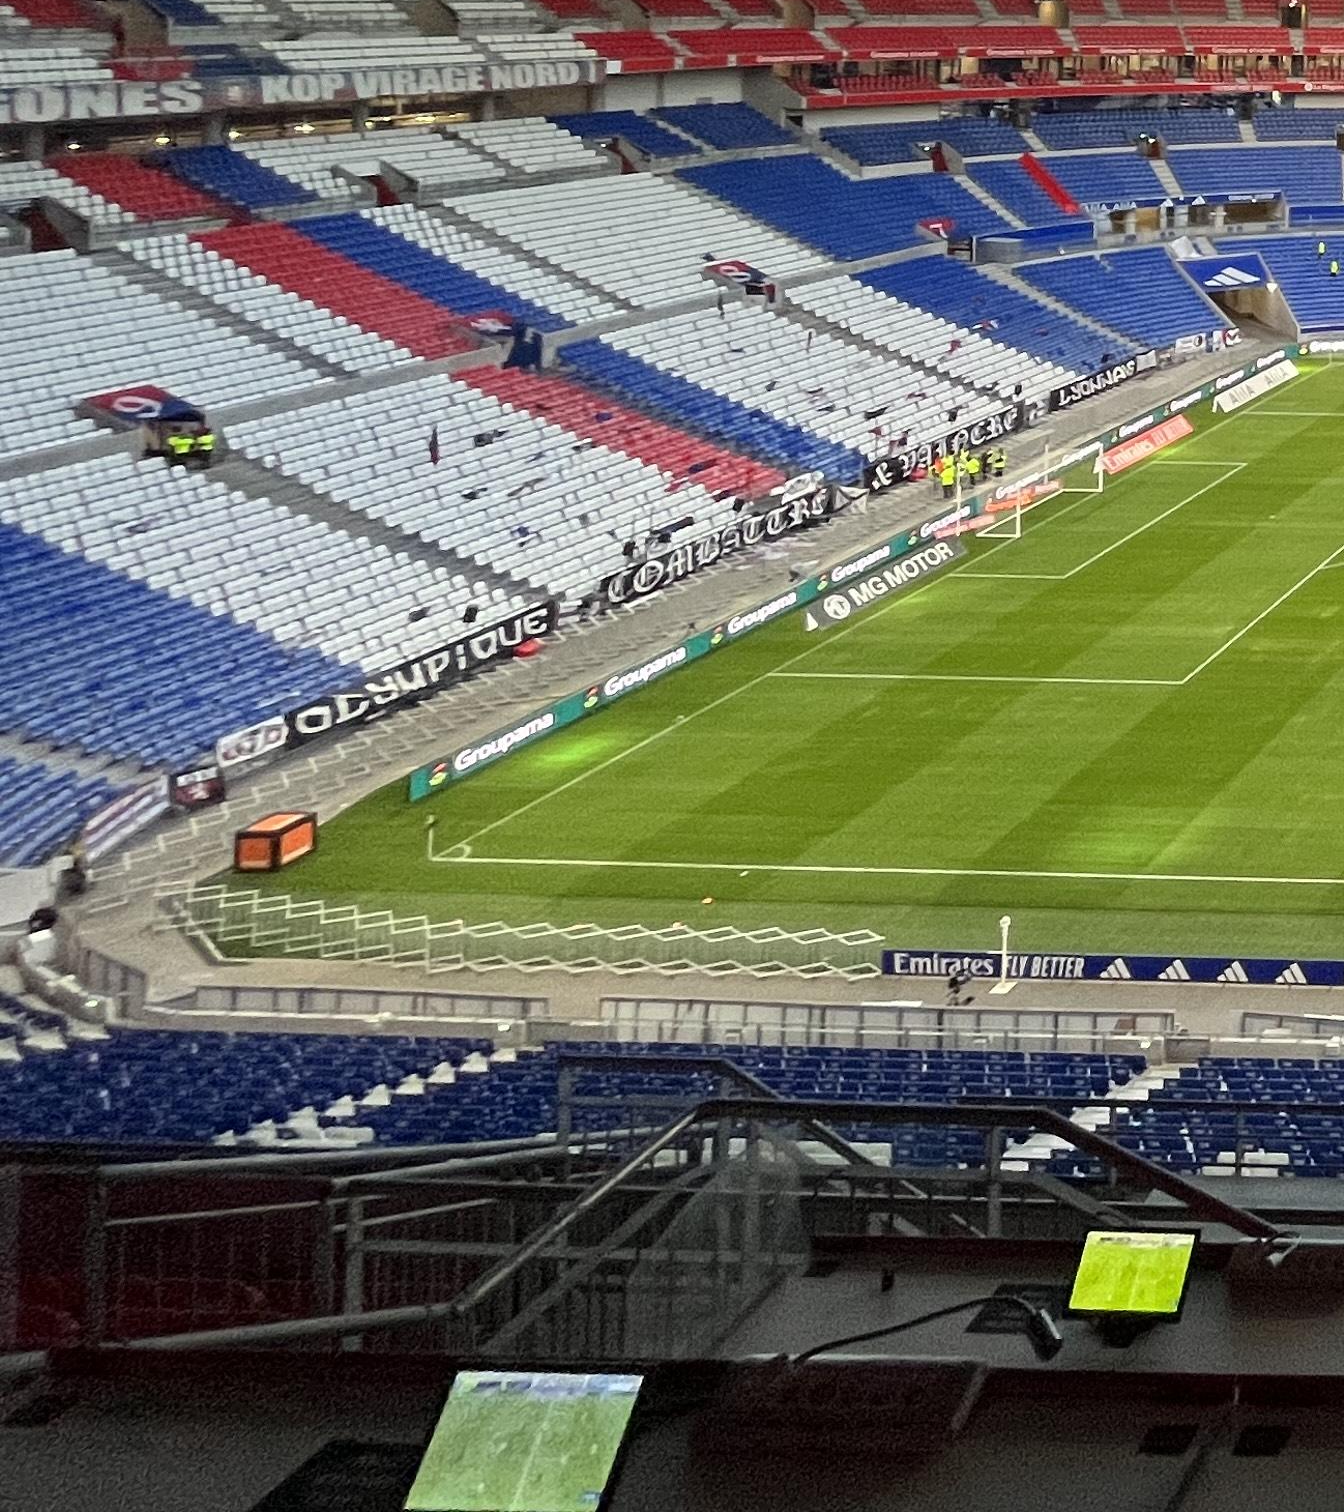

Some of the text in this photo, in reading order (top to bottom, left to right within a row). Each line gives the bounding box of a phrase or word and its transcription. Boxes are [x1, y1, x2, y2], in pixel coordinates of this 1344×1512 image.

[0, 80, 204, 123] ONES
[262, 61, 580, 104] KOP VIRAGE NORD
[831, 546, 891, 584] Groupama
[848, 541, 955, 607] MG MOTOR
[727, 591, 798, 635] Groupama
[603, 646, 687, 696] Groupama
[454, 713, 556, 772] Groupama
[893, 952, 994, 976] Emirates
[1030, 956, 1085, 978] BETTER
